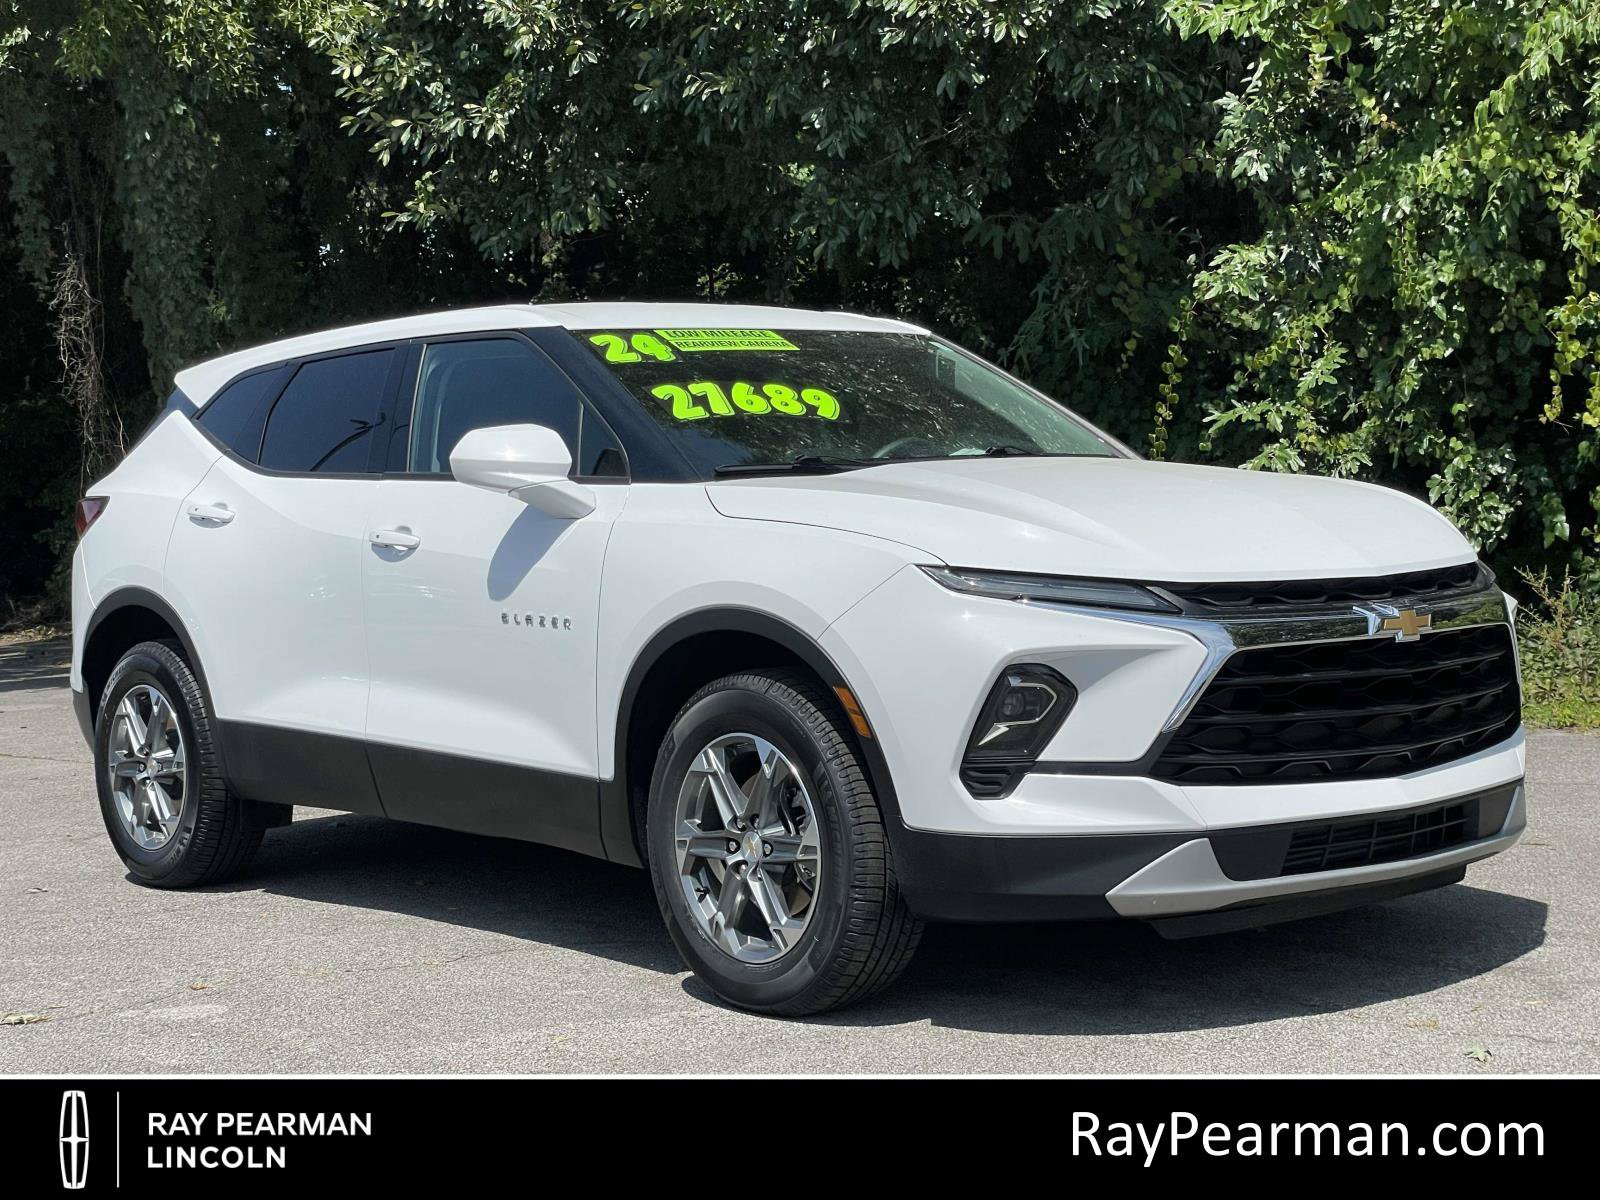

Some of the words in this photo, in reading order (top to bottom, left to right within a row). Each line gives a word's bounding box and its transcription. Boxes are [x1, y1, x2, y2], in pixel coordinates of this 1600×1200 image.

[664, 329, 701, 338] LOW
[702, 329, 772, 338] MILEAGE
[588, 333, 677, 363] 24
[674, 339, 737, 348] REARVIEW
[738, 339, 790, 348] CAMERA
[651, 381, 841, 421] 27689
[501, 612, 571, 631] BLAZER
